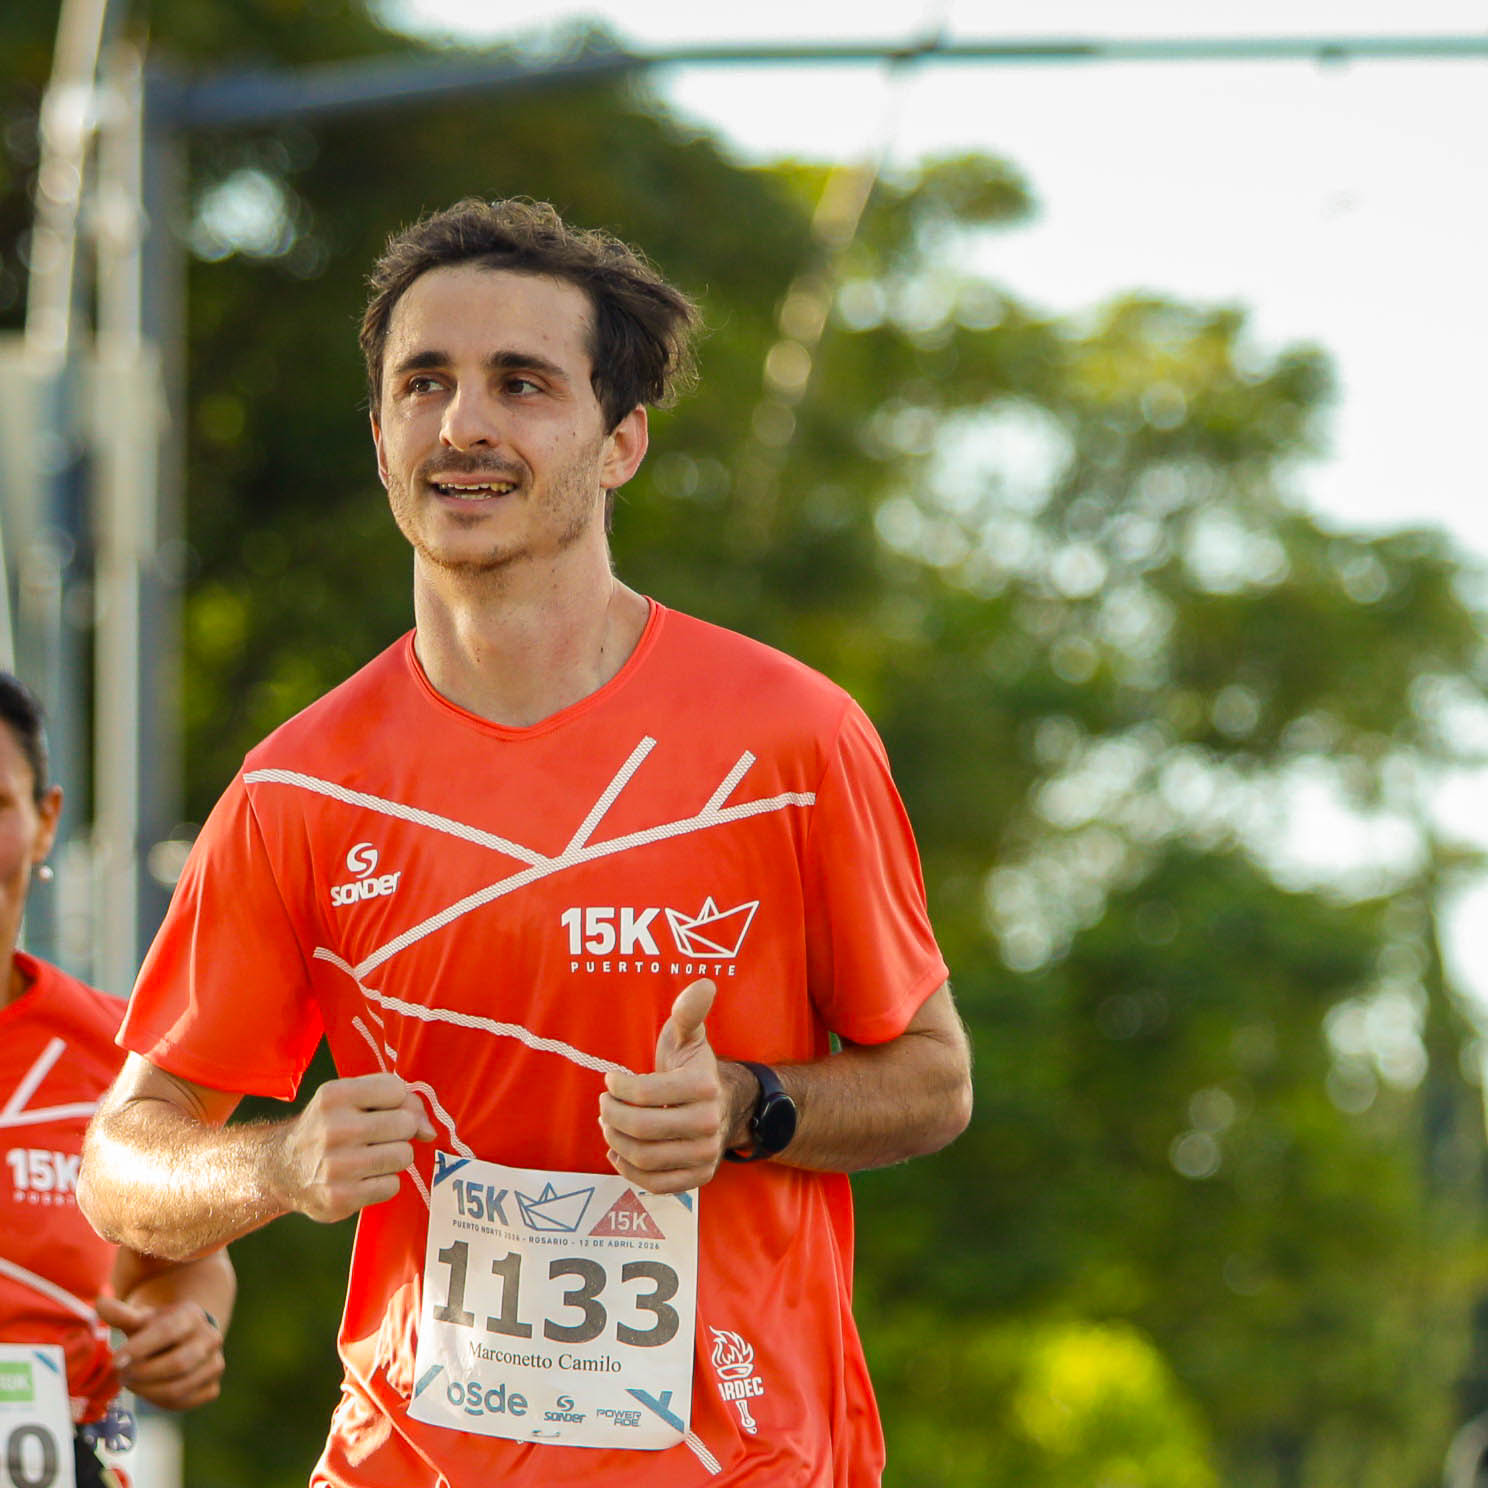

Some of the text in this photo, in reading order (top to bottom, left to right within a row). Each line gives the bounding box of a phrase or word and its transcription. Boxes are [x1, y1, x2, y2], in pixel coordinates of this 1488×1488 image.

[561, 907, 661, 956] 15K
[570, 961, 737, 976] PUERTO NORTE
[6, 1147, 80, 1193] 15K
[452, 1178, 509, 1227] 15K
[452, 1219, 479, 1232] PUERTO
[481, 1225, 502, 1237] NORTE
[528, 1236, 569, 1246] ROSARIO
[593, 1239, 604, 1248] DE
[607, 1240, 634, 1249] ABRIL
[608, 1211, 648, 1232] 15K
[433, 1240, 680, 1348] 1133
[469, 1341, 622, 1373] Marconetto Camilo
[447, 1381, 529, 1416] osde
[596, 1408, 642, 1419] POWER
